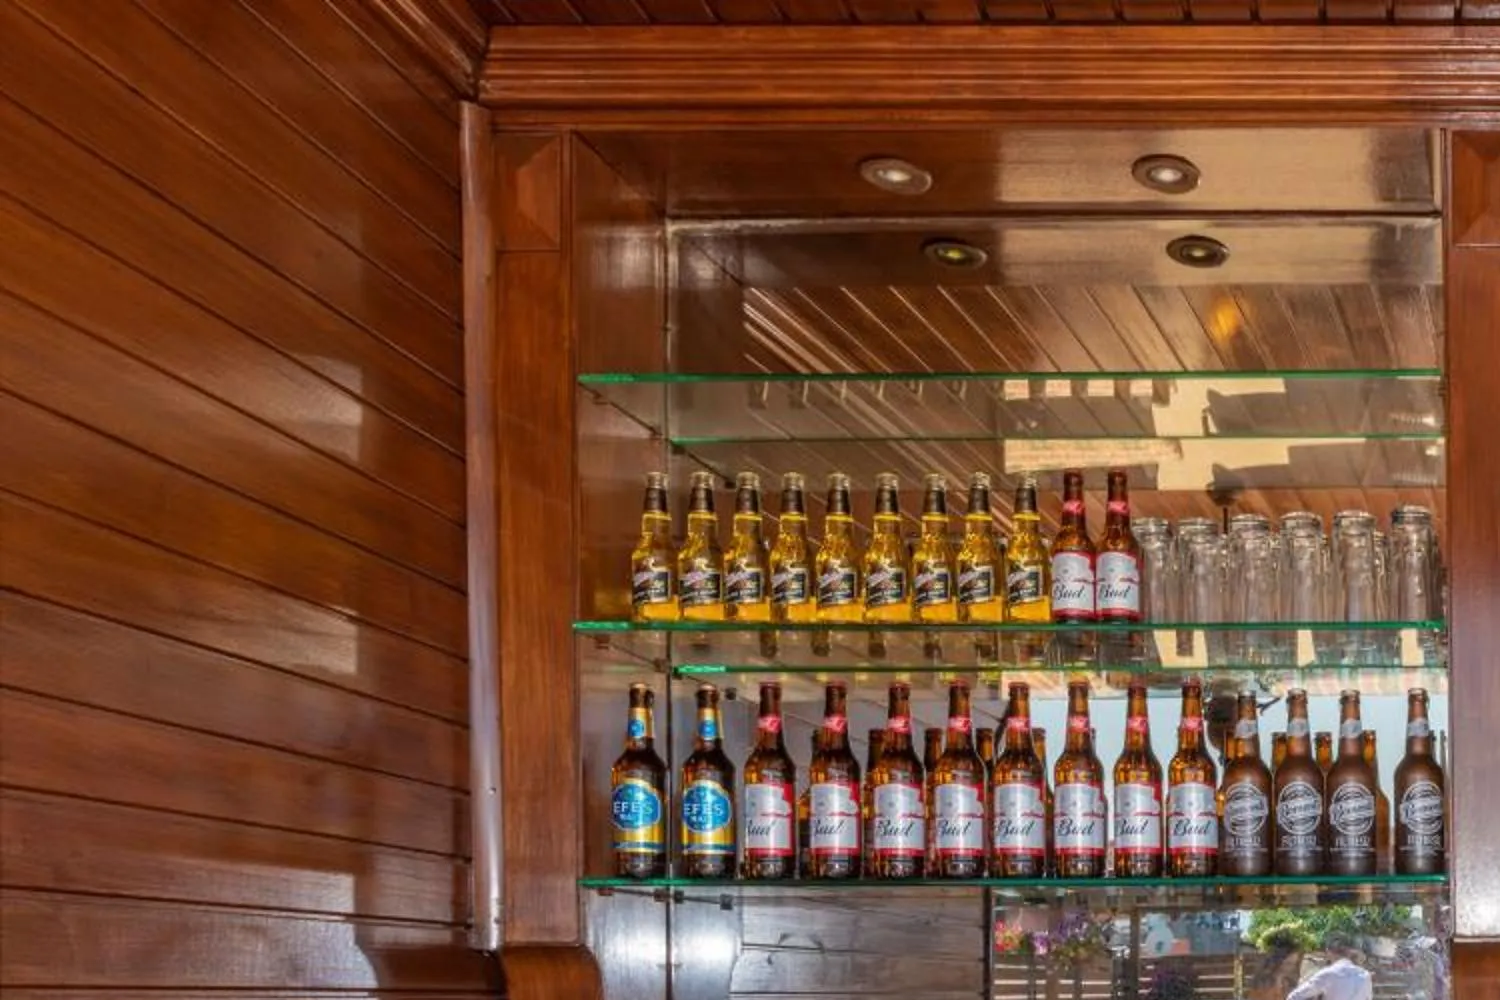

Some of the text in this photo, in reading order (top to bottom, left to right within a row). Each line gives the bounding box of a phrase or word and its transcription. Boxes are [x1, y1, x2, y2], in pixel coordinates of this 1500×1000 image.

[613, 801, 653, 815] EFES
[683, 803, 724, 816] EFES
[877, 819, 914, 837] Bud
[996, 819, 1035, 837] Bud
[1056, 818, 1096, 837] Bud
[1173, 818, 1212, 836] Bud
